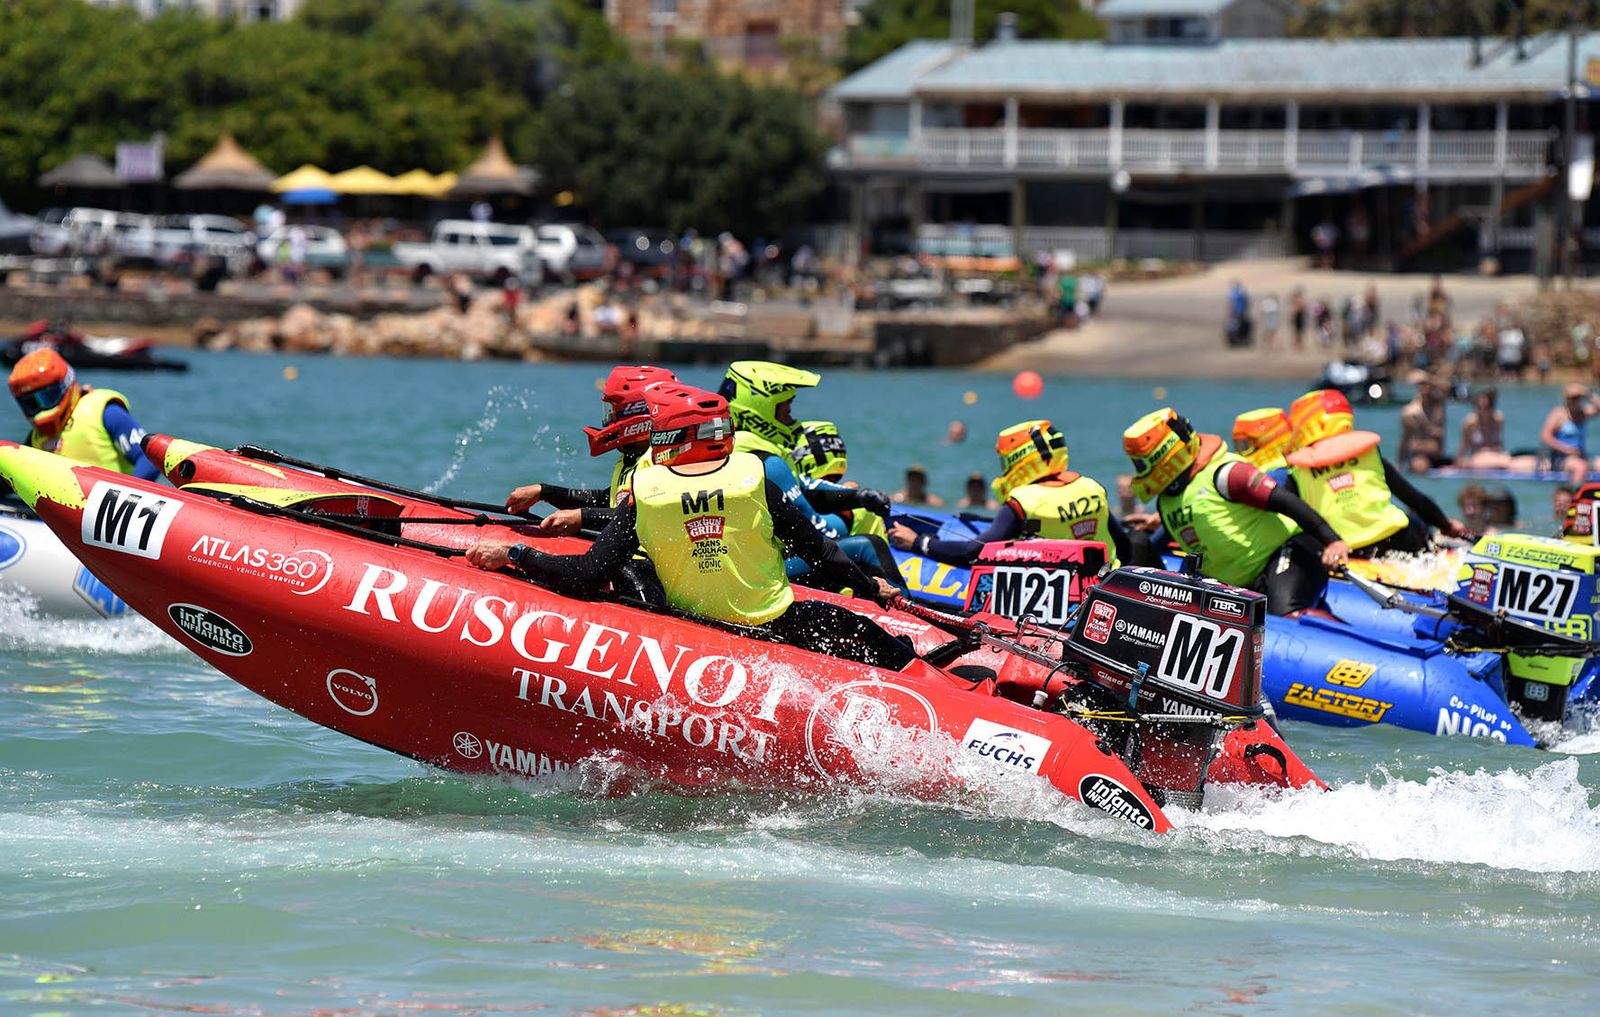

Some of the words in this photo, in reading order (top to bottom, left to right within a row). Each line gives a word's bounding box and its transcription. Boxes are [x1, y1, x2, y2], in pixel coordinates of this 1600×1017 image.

[681, 488, 724, 515] M1
[1057, 495, 1102, 522] M27
[1167, 505, 1193, 529] M27
[94, 488, 166, 551] M1
[690, 525, 722, 537] GRILL
[190, 535, 317, 579] ATLAS360
[695, 539, 720, 548] TRANS
[1507, 546, 1579, 566] FACTORY
[187, 555, 233, 571] COMMERCIAL
[236, 566, 266, 578] VEHICLE
[269, 574, 305, 587] SERVICES
[995, 571, 1065, 620] M21
[1152, 584, 1193, 604] YAMAHA
[1212, 599, 1238, 612] TBR
[1498, 567, 1575, 618] M27
[179, 608, 244, 645] infanta
[180, 619, 245, 653] INFLATABLES
[1127, 622, 1166, 646] YAMAHA
[342, 562, 790, 726] RUSGENOT
[1163, 619, 1238, 693] M1
[332, 682, 372, 700] VOLVO
[1284, 683, 1394, 722] FACTORY
[511, 666, 777, 764] TRANSPORT
[968, 739, 1036, 770] FUCHS
[1091, 779, 1150, 829] infanta
